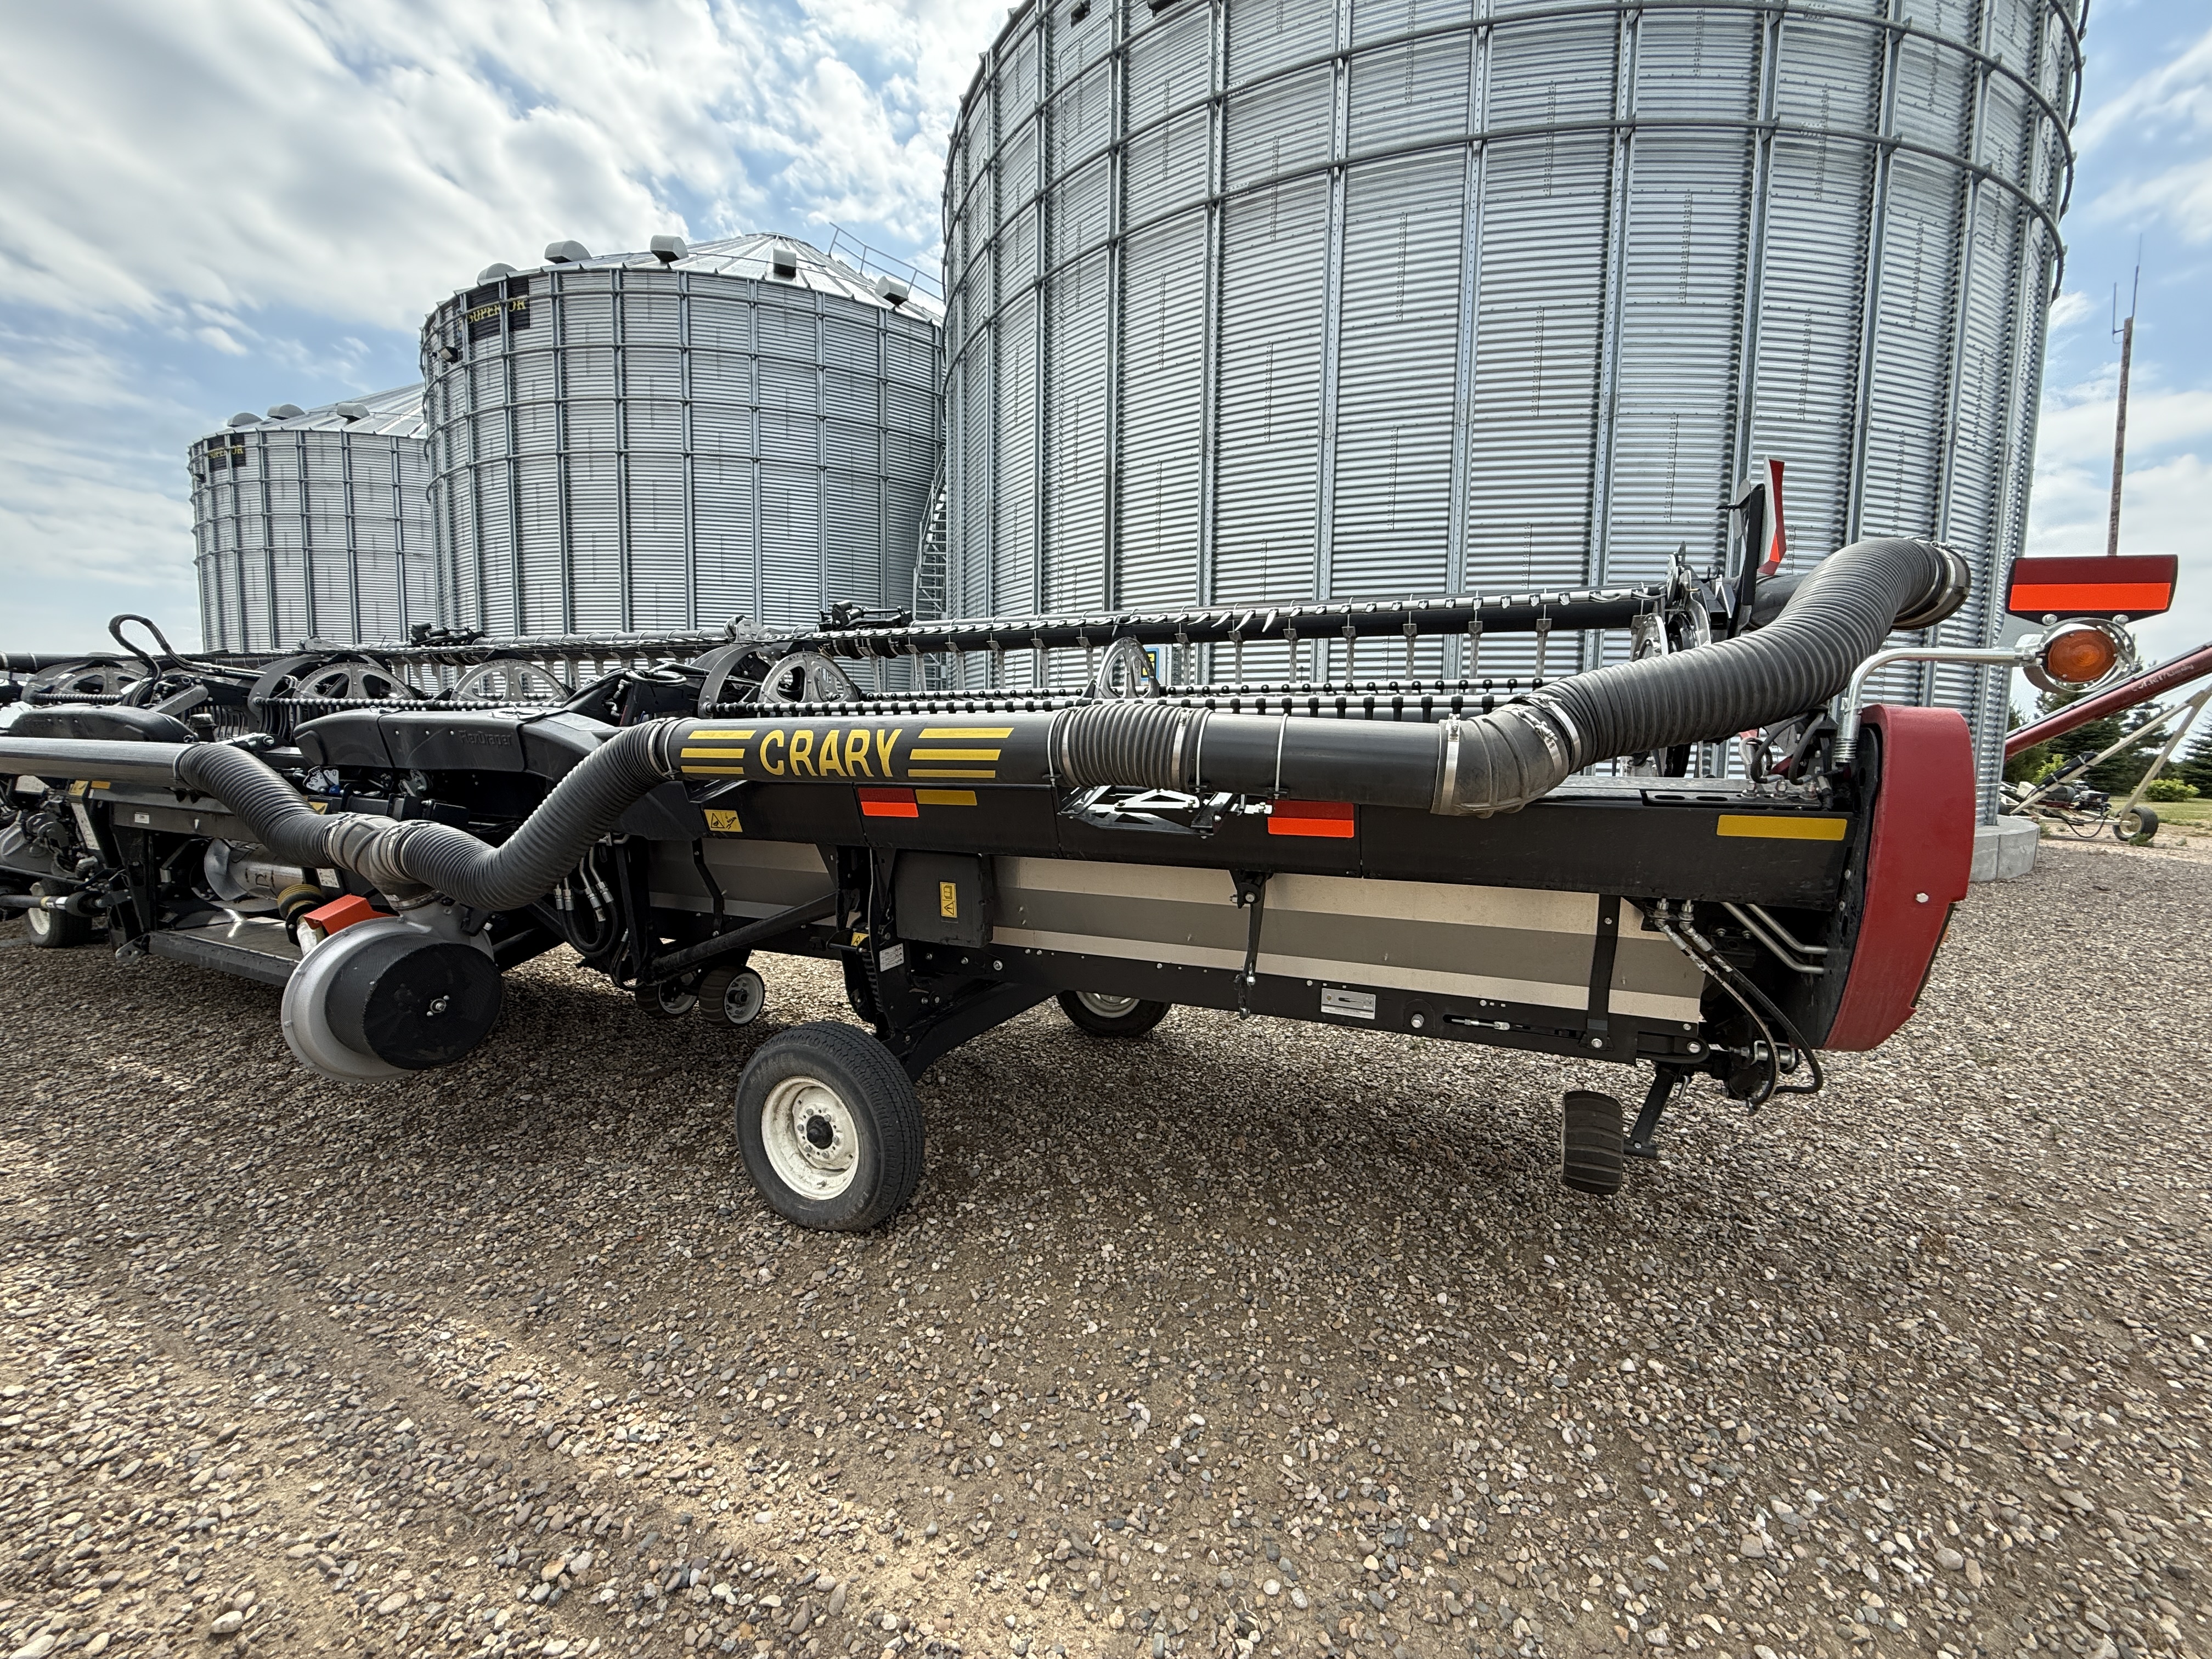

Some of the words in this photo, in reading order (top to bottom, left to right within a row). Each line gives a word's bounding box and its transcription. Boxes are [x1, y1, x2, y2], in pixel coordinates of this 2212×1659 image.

[467, 298, 527, 324] SUPEROR
[458, 730, 511, 747] FlexDraper
[760, 729, 903, 777] CRARY
